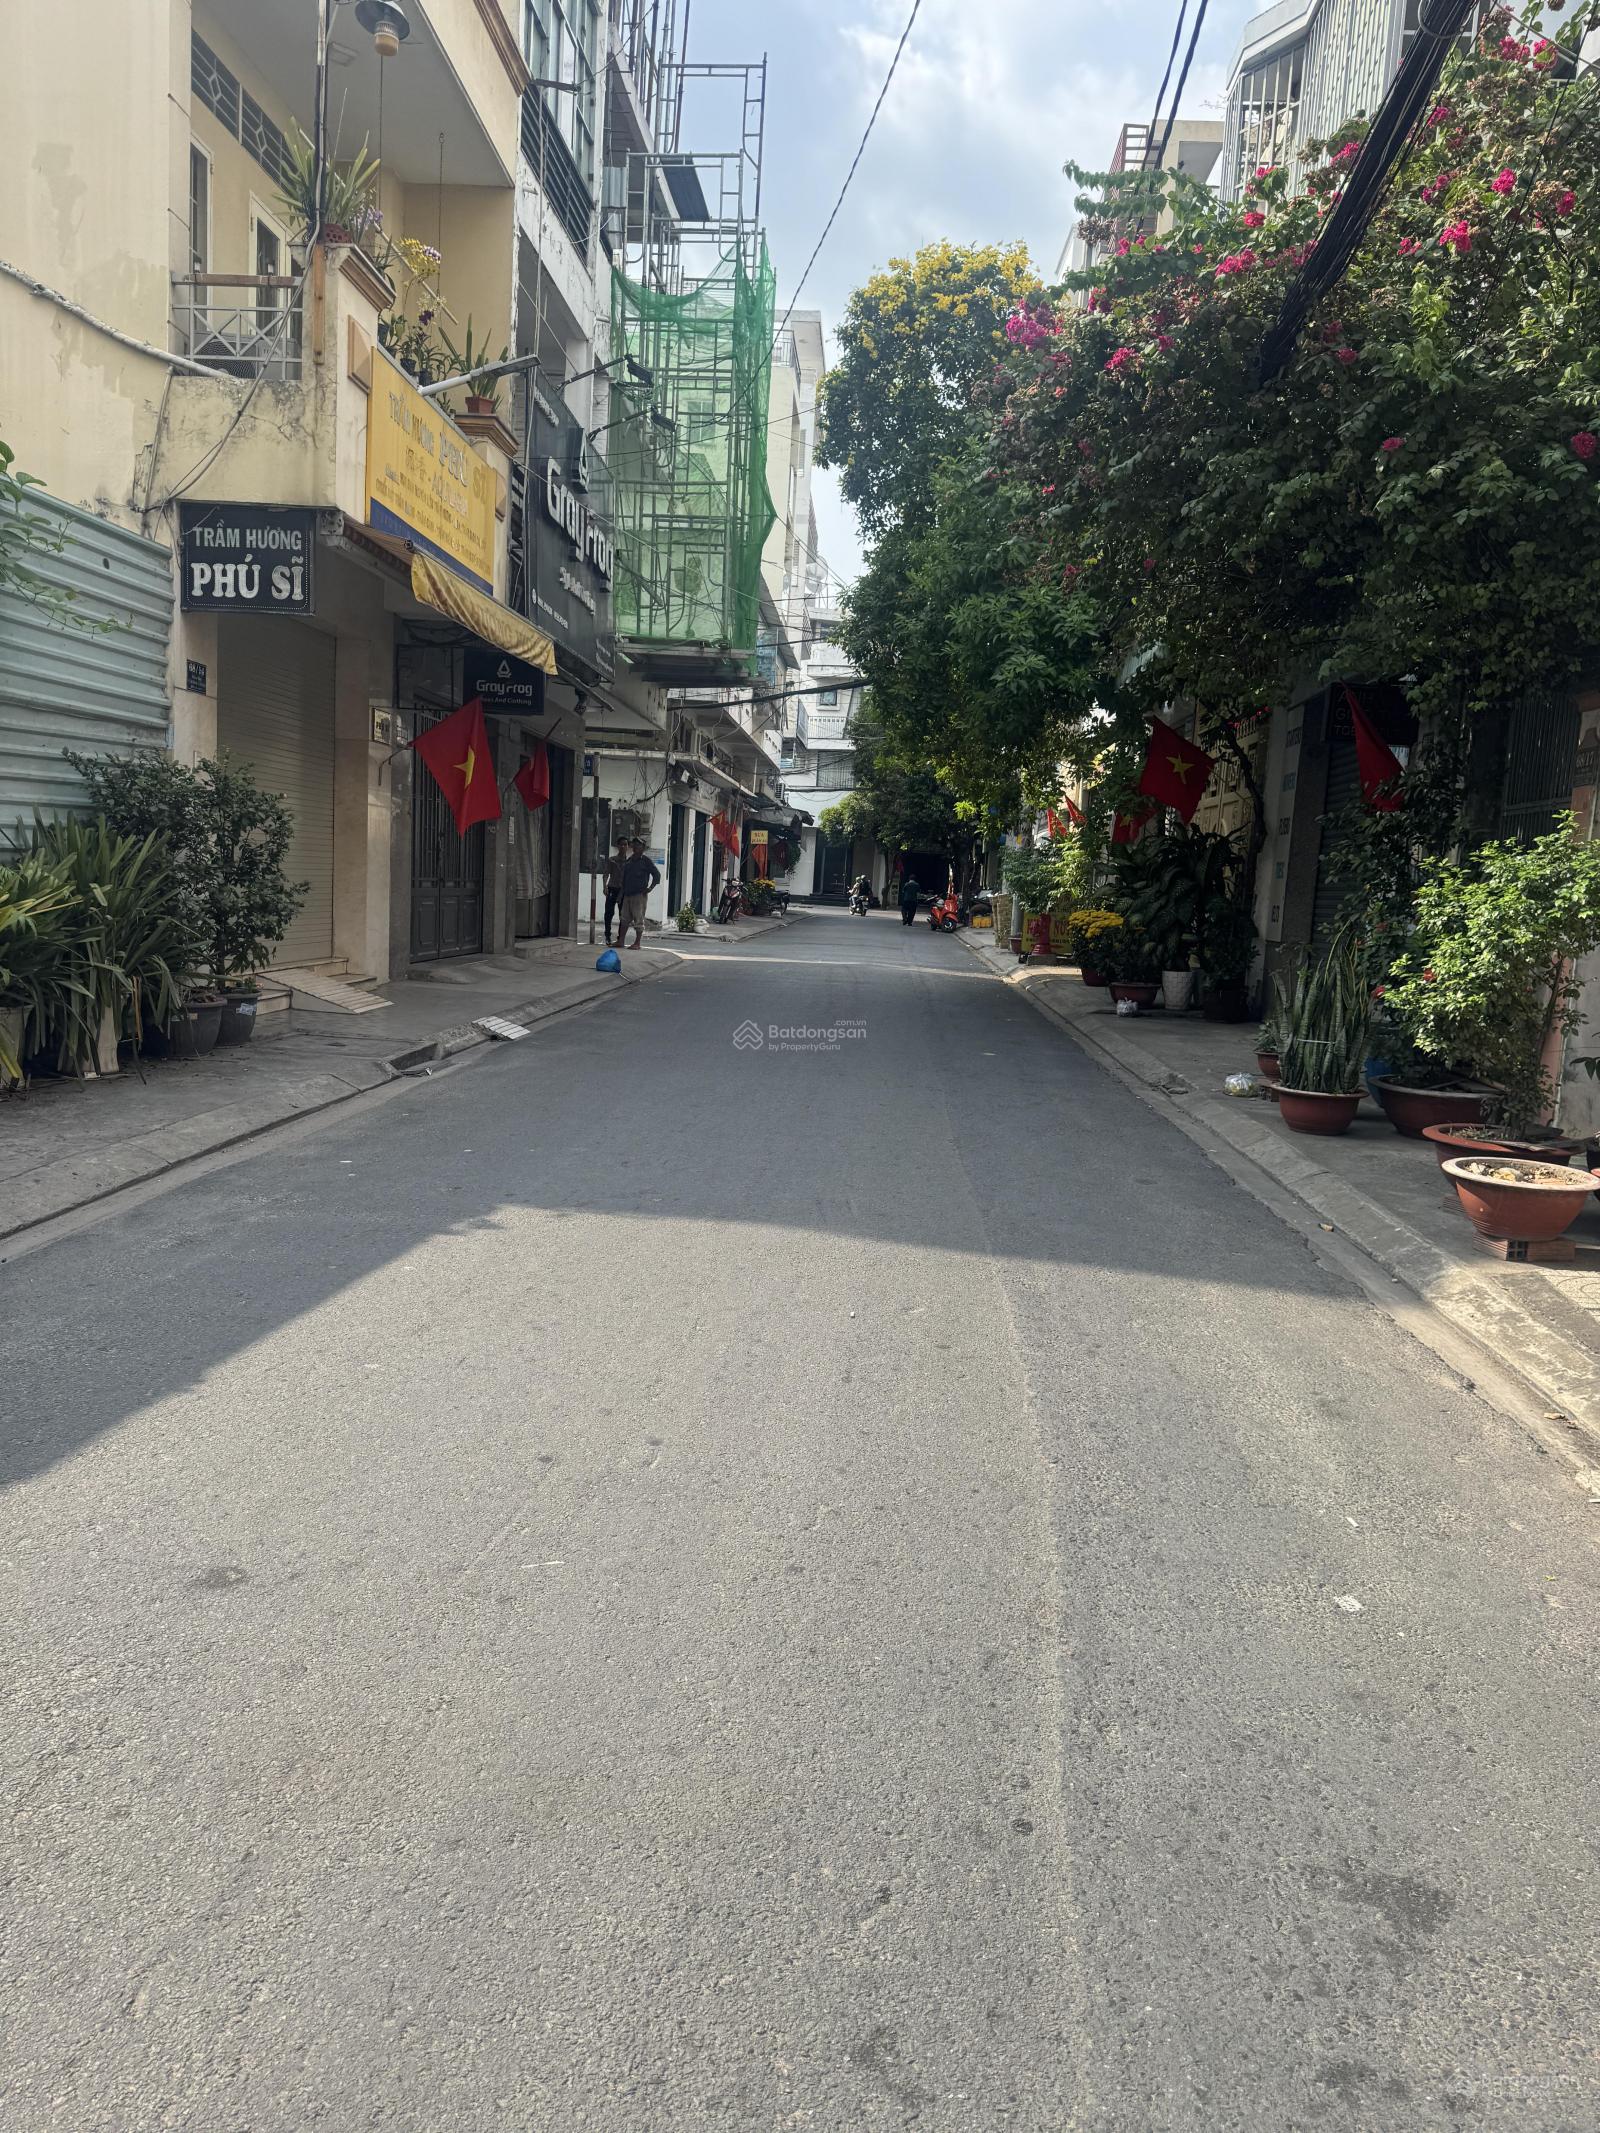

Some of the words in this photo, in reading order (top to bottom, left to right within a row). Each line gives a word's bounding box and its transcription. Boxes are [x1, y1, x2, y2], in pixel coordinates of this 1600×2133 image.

[192, 519, 241, 548] TRẦM
[246, 526, 302, 550] HƯƠNG
[190, 553, 262, 599] PHÚ
[271, 555, 304, 601] SĨ
